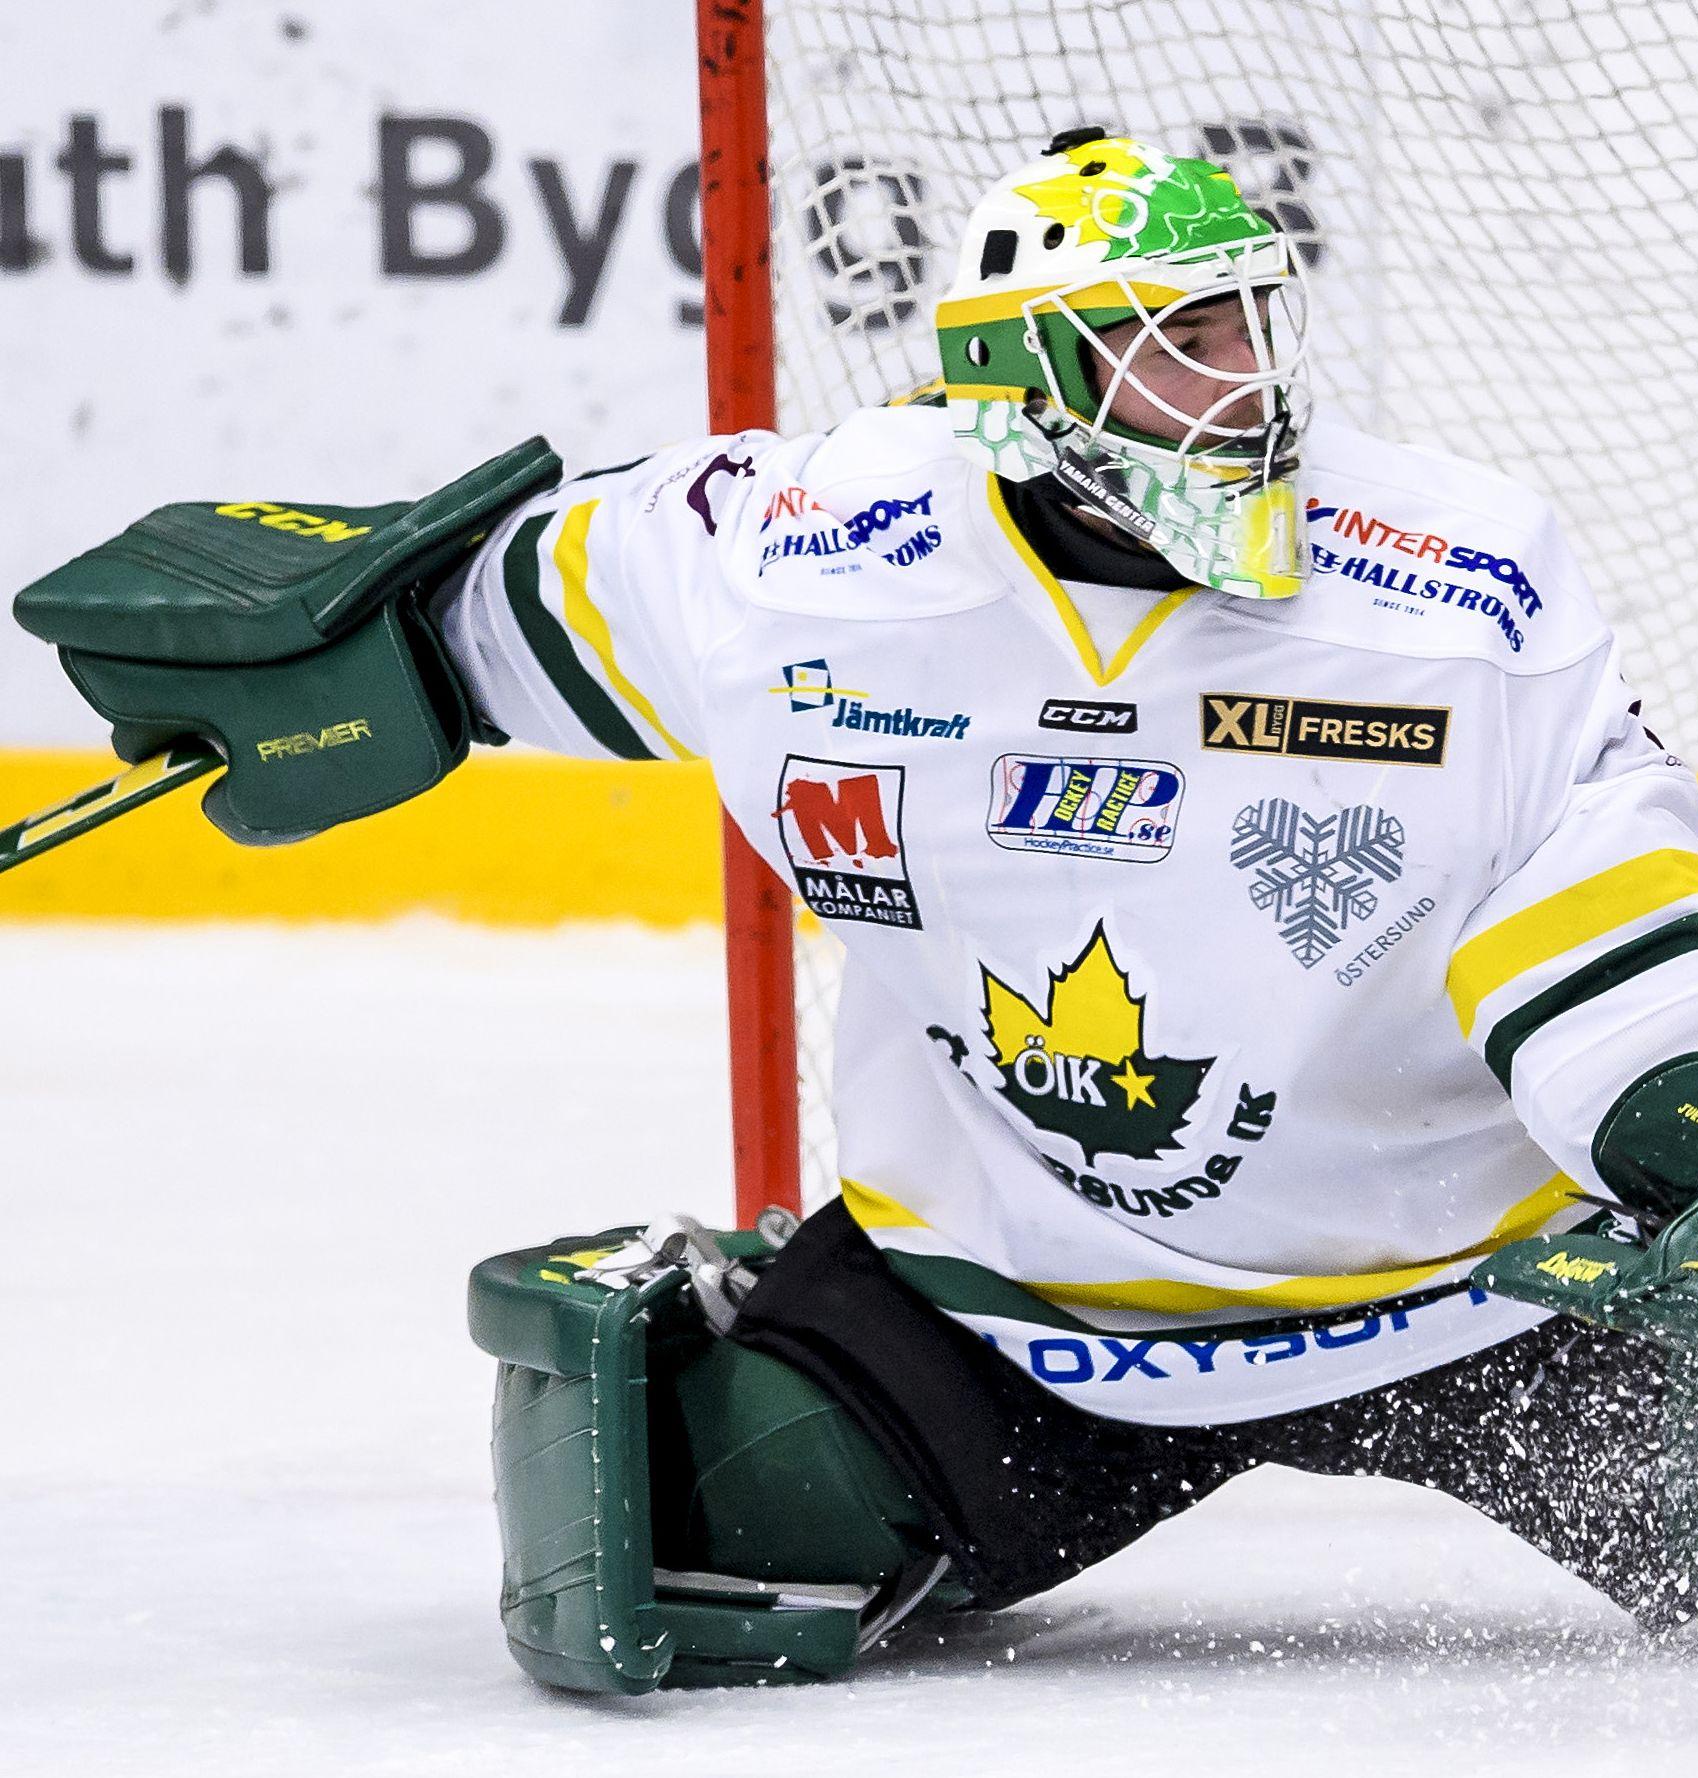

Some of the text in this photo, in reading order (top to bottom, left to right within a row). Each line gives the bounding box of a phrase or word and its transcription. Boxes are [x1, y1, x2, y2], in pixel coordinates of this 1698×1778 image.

[1059, 459, 1155, 533] YAMAHA CENTER
[215, 502, 371, 543] CCM
[1333, 508, 1544, 619] INTERSPORT
[832, 698, 971, 740] Jämtkraft
[1043, 706, 1133, 727] CCM
[1206, 699, 1281, 748] XL
[1298, 716, 1437, 750] FRESKS
[257, 717, 373, 763] PREMIER
[805, 874, 911, 910] MÅLAR
[811, 901, 914, 925] KOMPANIET
[1333, 896, 1436, 987] ÖSTERSUND
[1015, 1034, 1107, 1107] ÖIK
